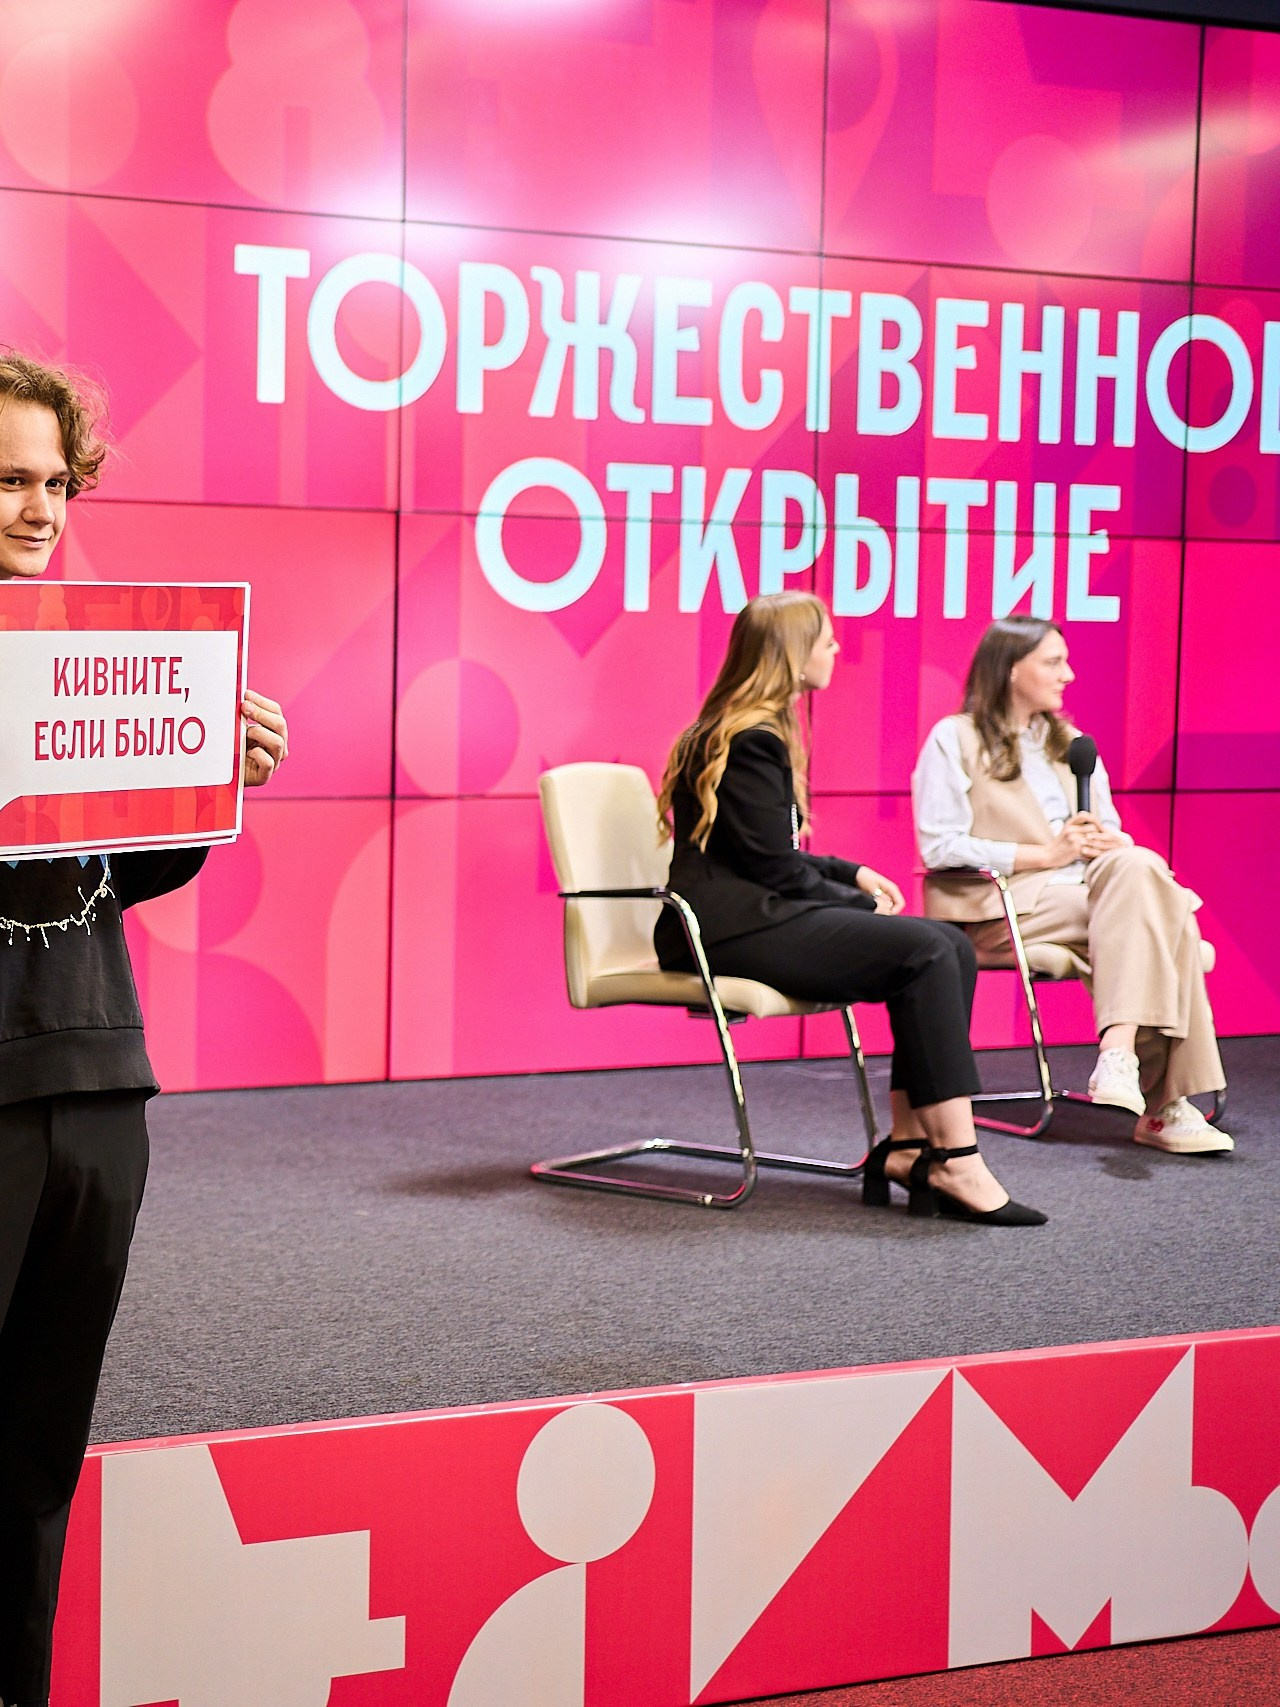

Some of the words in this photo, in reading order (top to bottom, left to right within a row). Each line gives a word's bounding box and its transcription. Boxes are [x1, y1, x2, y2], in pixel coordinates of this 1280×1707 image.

[474, 456, 1122, 622] ОТКРЫТИЕ
[53, 656, 190, 703] КИВНИТЕ,
[34, 719, 105, 761] ЕСЛИ
[115, 716, 206, 758] БЫЛО
